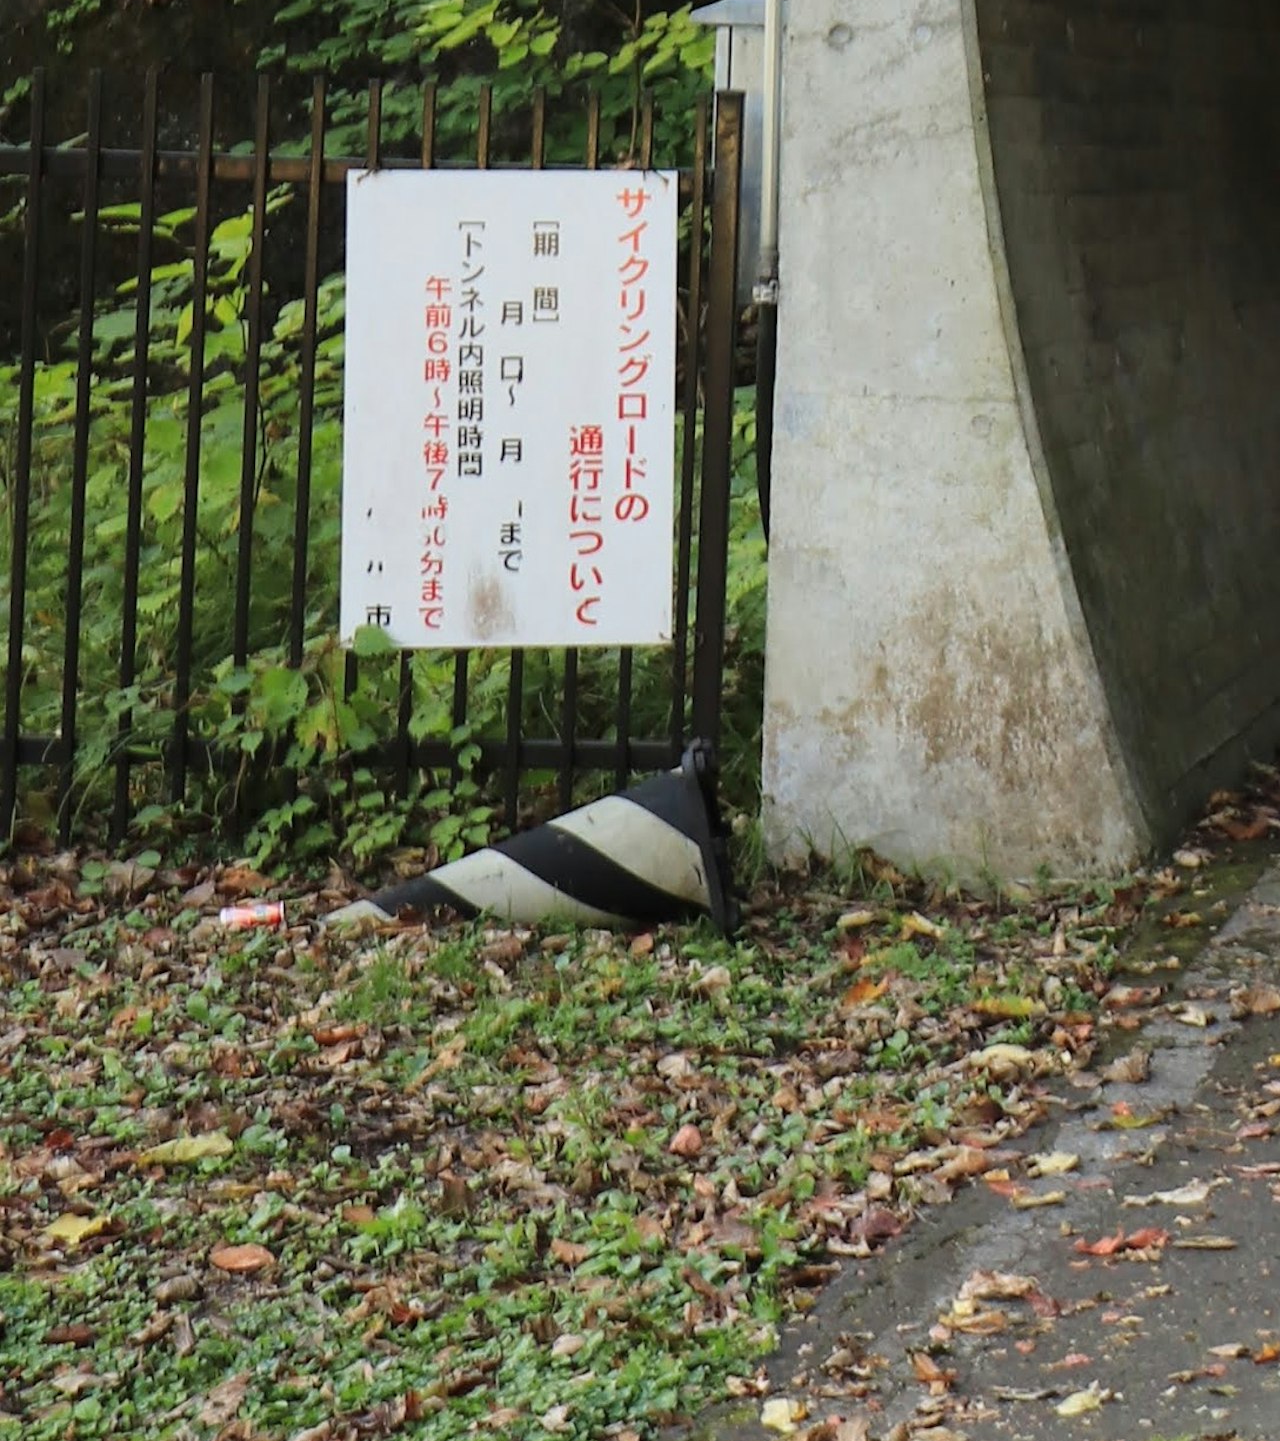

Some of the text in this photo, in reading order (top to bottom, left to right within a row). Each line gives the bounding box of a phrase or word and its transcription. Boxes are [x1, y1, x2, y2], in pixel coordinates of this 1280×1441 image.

[617, 187, 651, 523] サイクリングロードの
